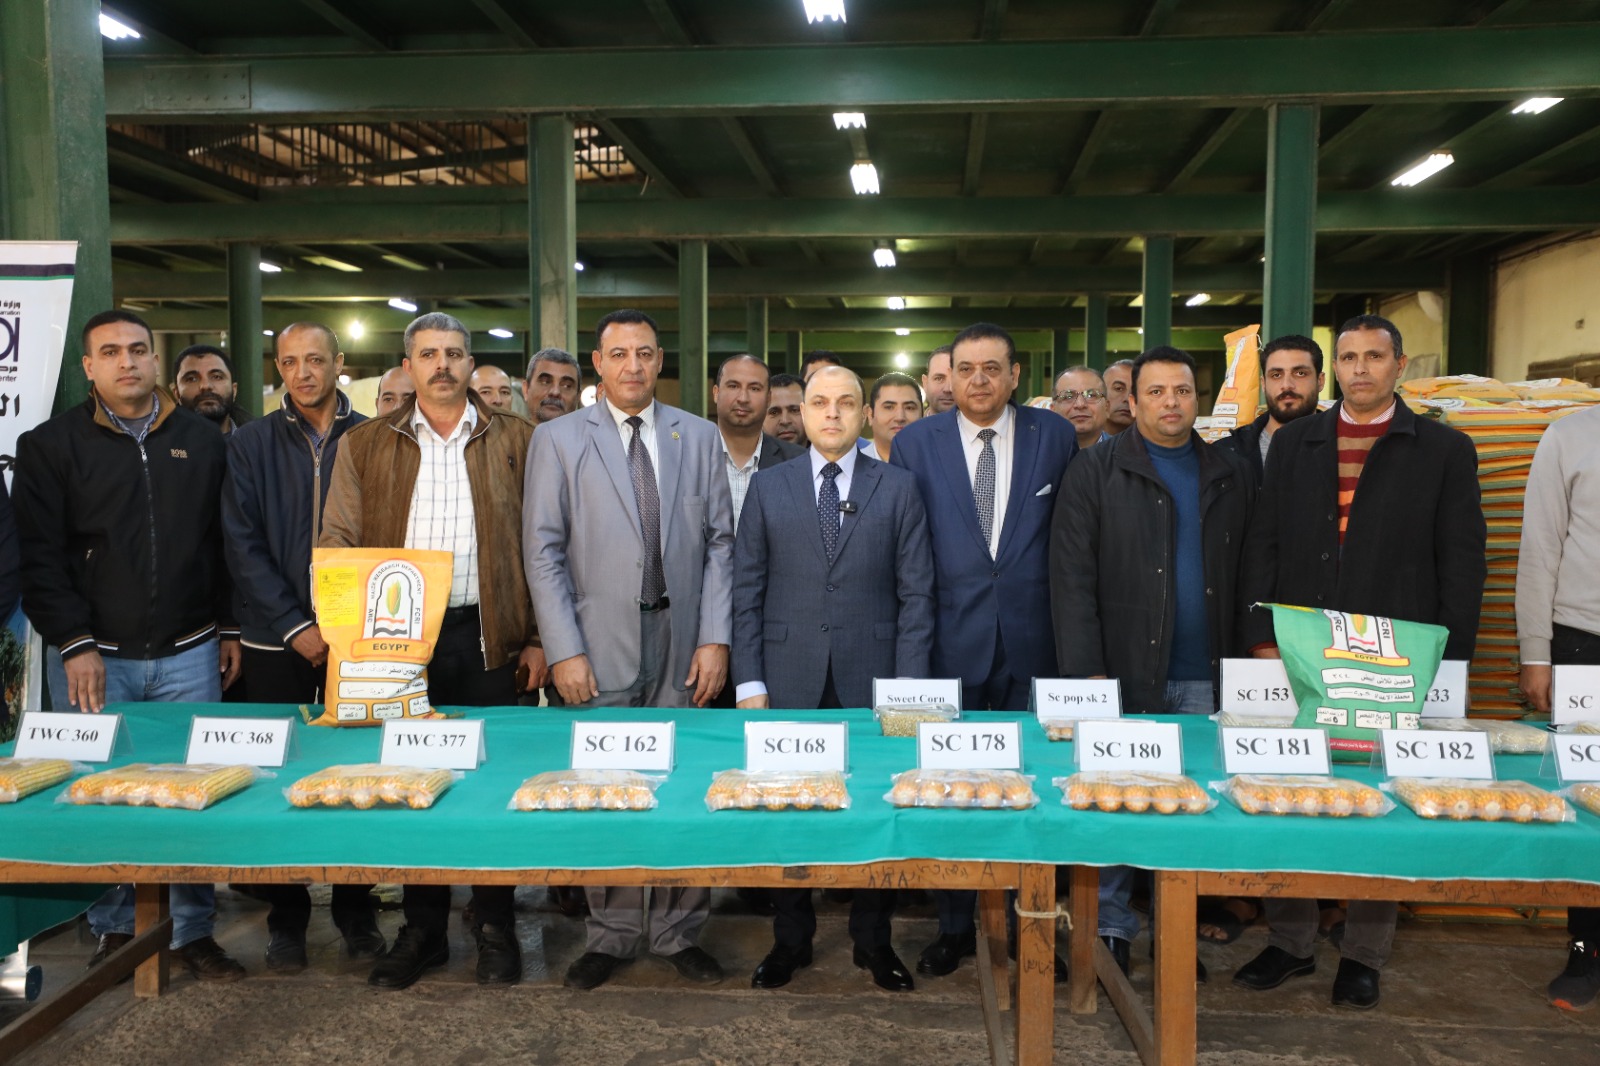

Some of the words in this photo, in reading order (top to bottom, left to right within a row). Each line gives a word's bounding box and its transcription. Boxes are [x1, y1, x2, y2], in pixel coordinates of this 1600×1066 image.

[372, 642, 410, 652] EGYPT
[1354, 654, 1378, 662] EGYPT
[887, 694, 916, 703] Sweet
[920, 694, 945, 703] Corn
[1048, 692, 1060, 702] Sc
[1064, 694, 1083, 704] pop
[1086, 694, 1098, 703] sk
[1102, 694, 1108, 703] 2
[1237, 688, 1258, 702] SC
[1264, 688, 1290, 702] 153
[1568, 696, 1594, 709] SC
[28, 727, 69, 742] TWC
[71, 729, 99, 743] 360
[202, 730, 242, 744] TWC
[246, 731, 274, 745] 368
[394, 733, 434, 746] TWC
[438, 734, 467, 748] 377
[585, 735, 616, 752] SC
[623, 735, 657, 752] 162
[764, 738, 826, 754] SC168
[932, 734, 962, 752] SC
[970, 734, 1006, 752] 178
[1093, 741, 1122, 758] SC
[1129, 742, 1162, 759] 180
[1236, 738, 1268, 756] SC
[1276, 738, 1312, 756] 181
[1396, 741, 1428, 759] SC
[1437, 741, 1475, 760] 182
[1569, 744, 1600, 762] SC
